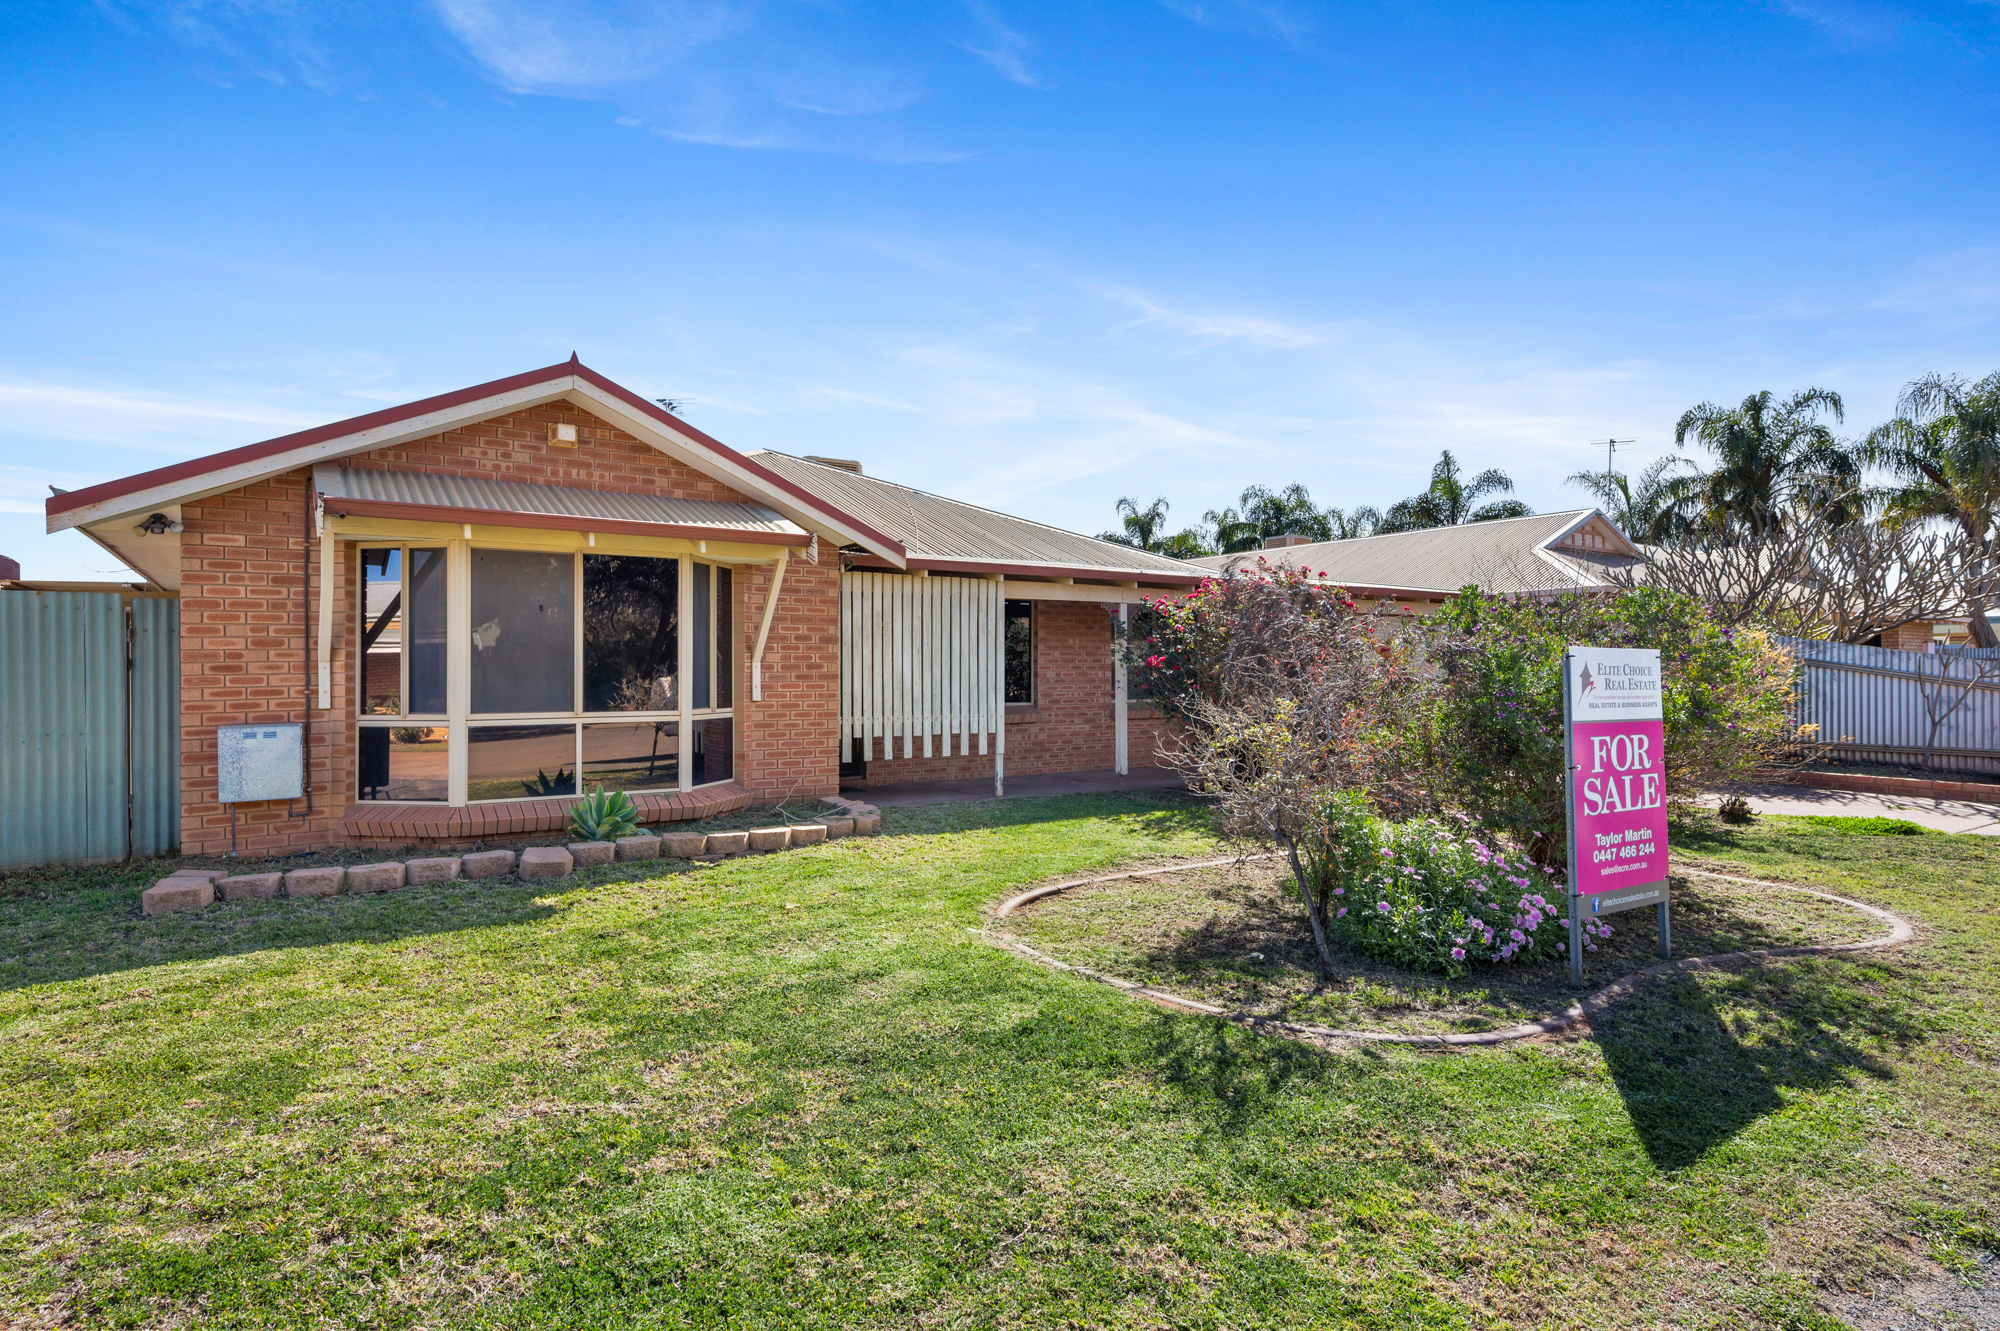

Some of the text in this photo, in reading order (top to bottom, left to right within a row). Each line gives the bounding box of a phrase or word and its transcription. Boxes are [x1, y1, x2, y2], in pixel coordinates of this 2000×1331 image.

[1597, 663, 1652, 676] ELITE CHOICE
[1605, 678, 1656, 690] REAL ESTATE
[1590, 734, 1652, 773] FOR
[1583, 773, 1661, 816] SALE
[1595, 827, 1652, 847] Taylor Martin
[1593, 842, 1655, 863] 0447 466 244
[1601, 862, 1648, 875] sales@ecre.com.au
